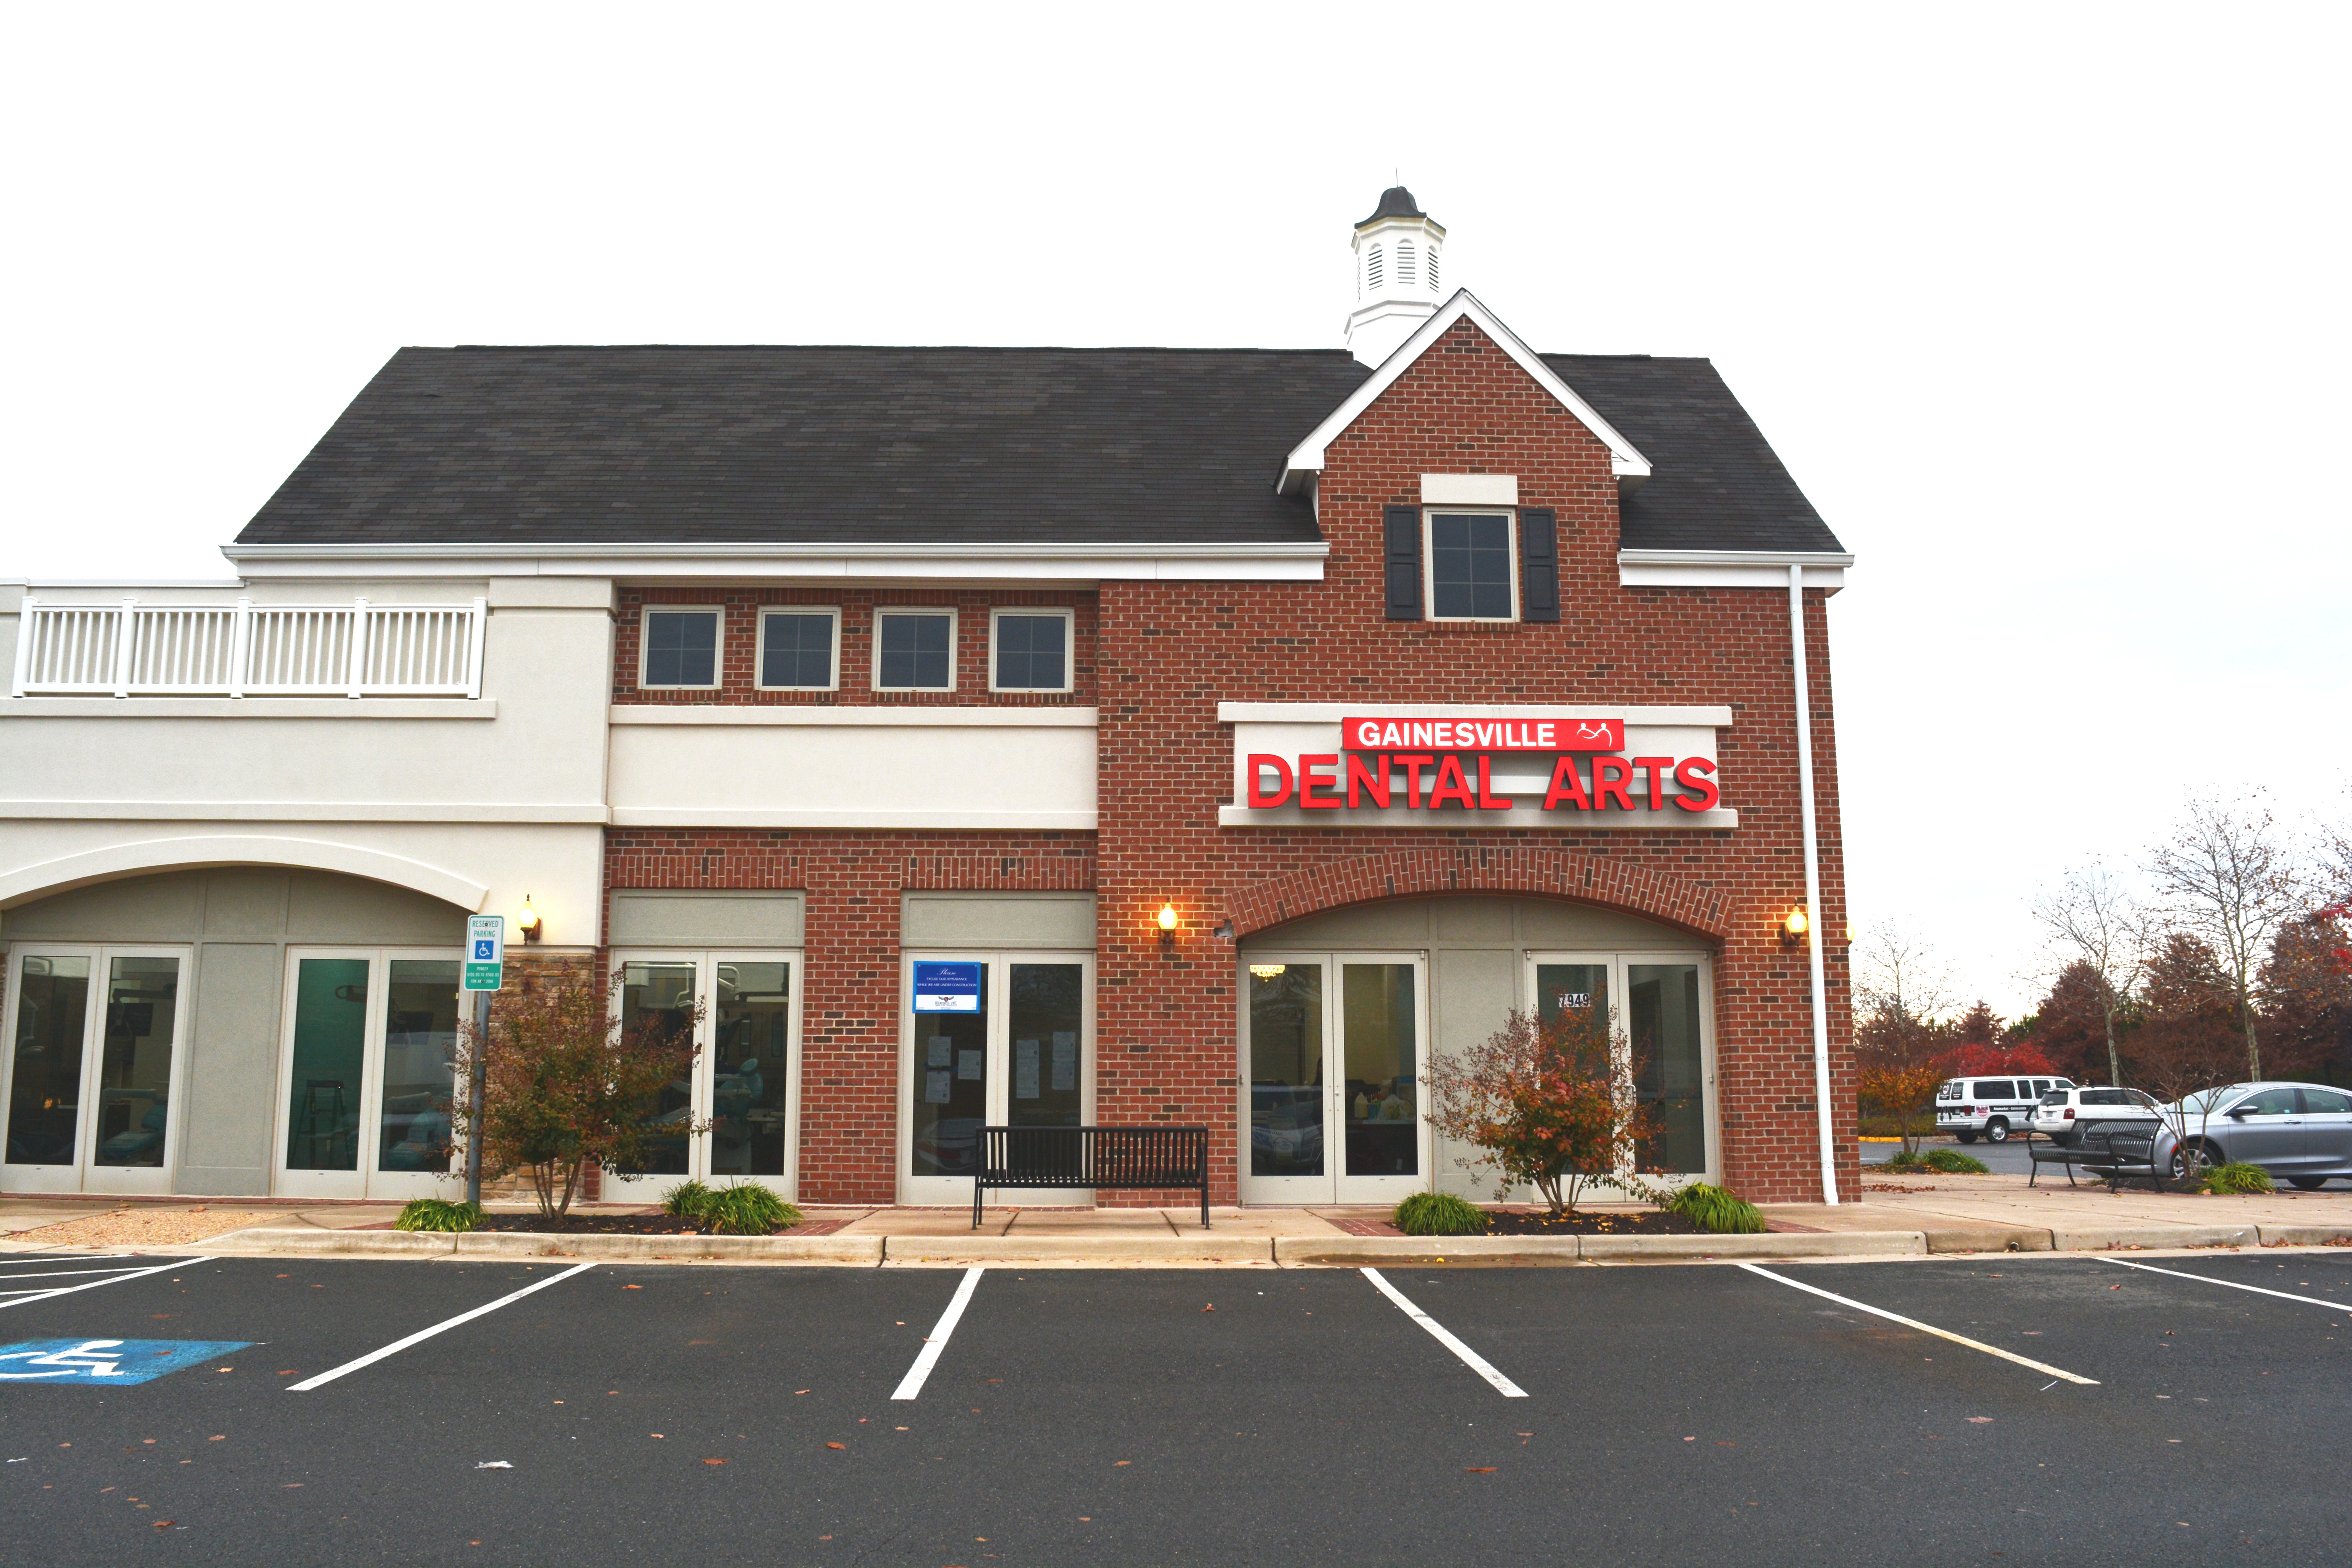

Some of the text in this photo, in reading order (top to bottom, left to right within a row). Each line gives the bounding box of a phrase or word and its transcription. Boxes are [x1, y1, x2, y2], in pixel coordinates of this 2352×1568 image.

[1358, 722, 1556, 747] GAINESVILLE
[1248, 753, 1719, 811] DENTAL ARTS
[1559, 994, 1589, 1007] 7949
